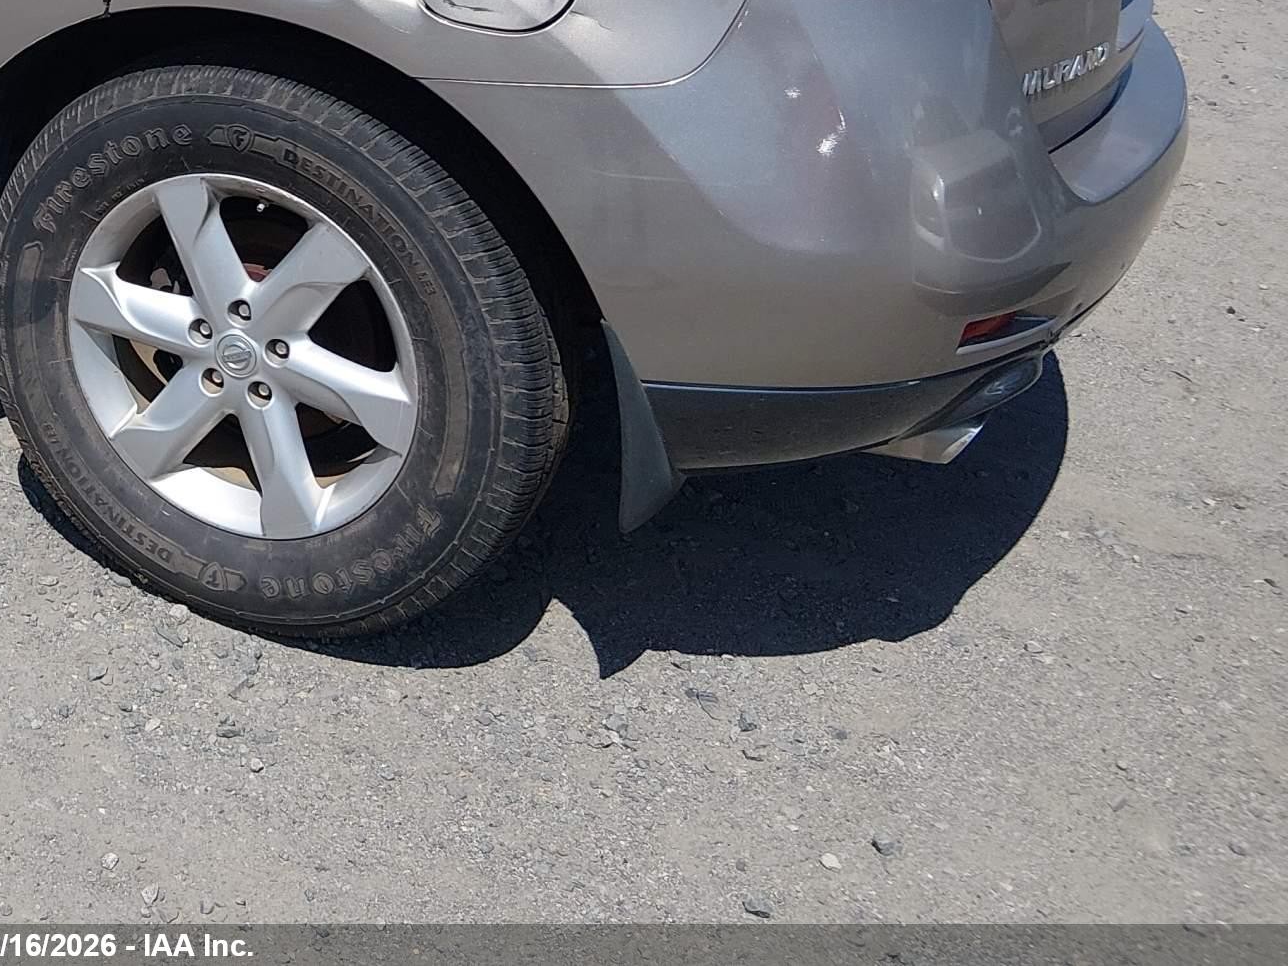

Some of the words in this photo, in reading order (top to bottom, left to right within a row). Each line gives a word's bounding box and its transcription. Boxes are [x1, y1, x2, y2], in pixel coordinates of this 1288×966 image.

[1022, 42, 1110, 96] MURANO
[32, 124, 193, 233] Firestone
[283, 148, 417, 267] DESTINATION
[59, 447, 174, 563] DESTINATION
[262, 503, 441, 598] Firestone
